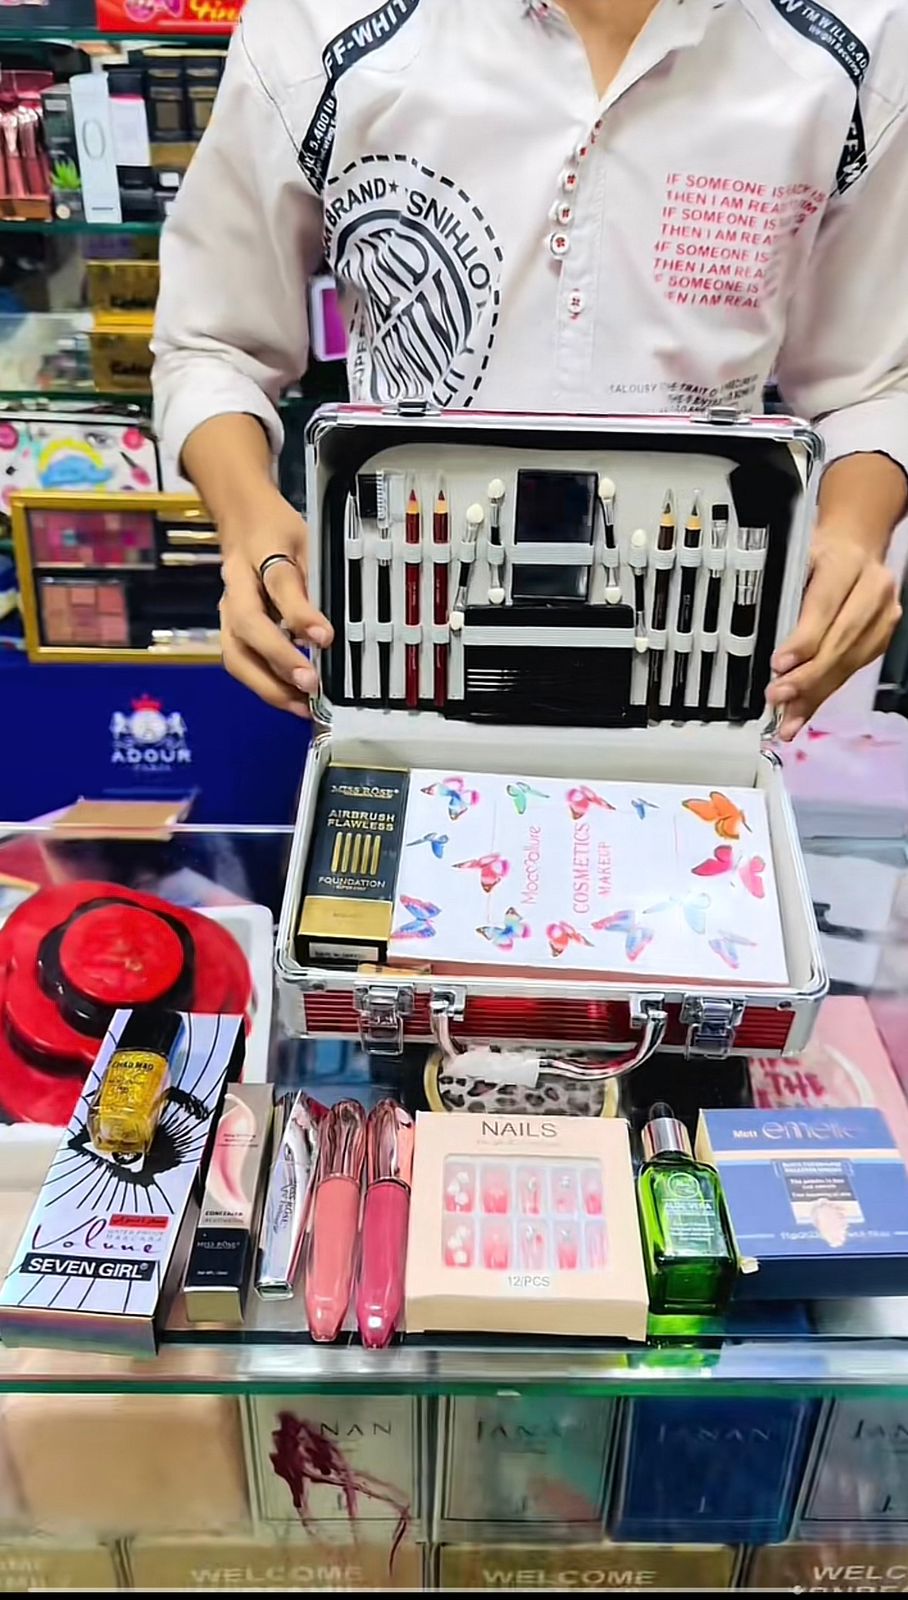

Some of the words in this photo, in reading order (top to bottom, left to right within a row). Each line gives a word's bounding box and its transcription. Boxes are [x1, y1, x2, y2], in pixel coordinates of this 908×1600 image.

[324, 0, 417, 79] FF-WHIT
[666, 173, 682, 185] IF
[685, 174, 768, 197] SOMEONE
[324, 177, 387, 229] BRAND
[666, 189, 707, 205] THEN
[721, 197, 745, 210] AM
[662, 206, 678, 219] IF
[682, 207, 758, 228] SOMEONE
[763, 218, 777, 231] IS
[661, 223, 701, 239] THEN
[715, 229, 737, 243] AM
[675, 242, 752, 262] SOMEONE
[754, 250, 770, 264] IS
[653, 257, 696, 274] THEN
[707, 263, 731, 275] AM
[668, 275, 744, 293] SOMEONE
[699, 293, 722, 306] AM
[111, 748, 192, 763] ADOUR
[327, 818, 394, 832] FLAWLESS
[328, 809, 395, 823] AIRBRUSH
[572, 821, 591, 915] COSMETICS
[597, 841, 611, 897] MAKEUP
[318, 876, 387, 889] FOUNDATION
[482, 1120, 558, 1138] NAILS
[28, 1258, 97, 1276] SEVEN
[98, 1262, 143, 1279] GIRL
[320, 1420, 392, 1436] NAN
[190, 1565, 364, 1583] WELCOME
[482, 1569, 657, 1586] WELCOME
